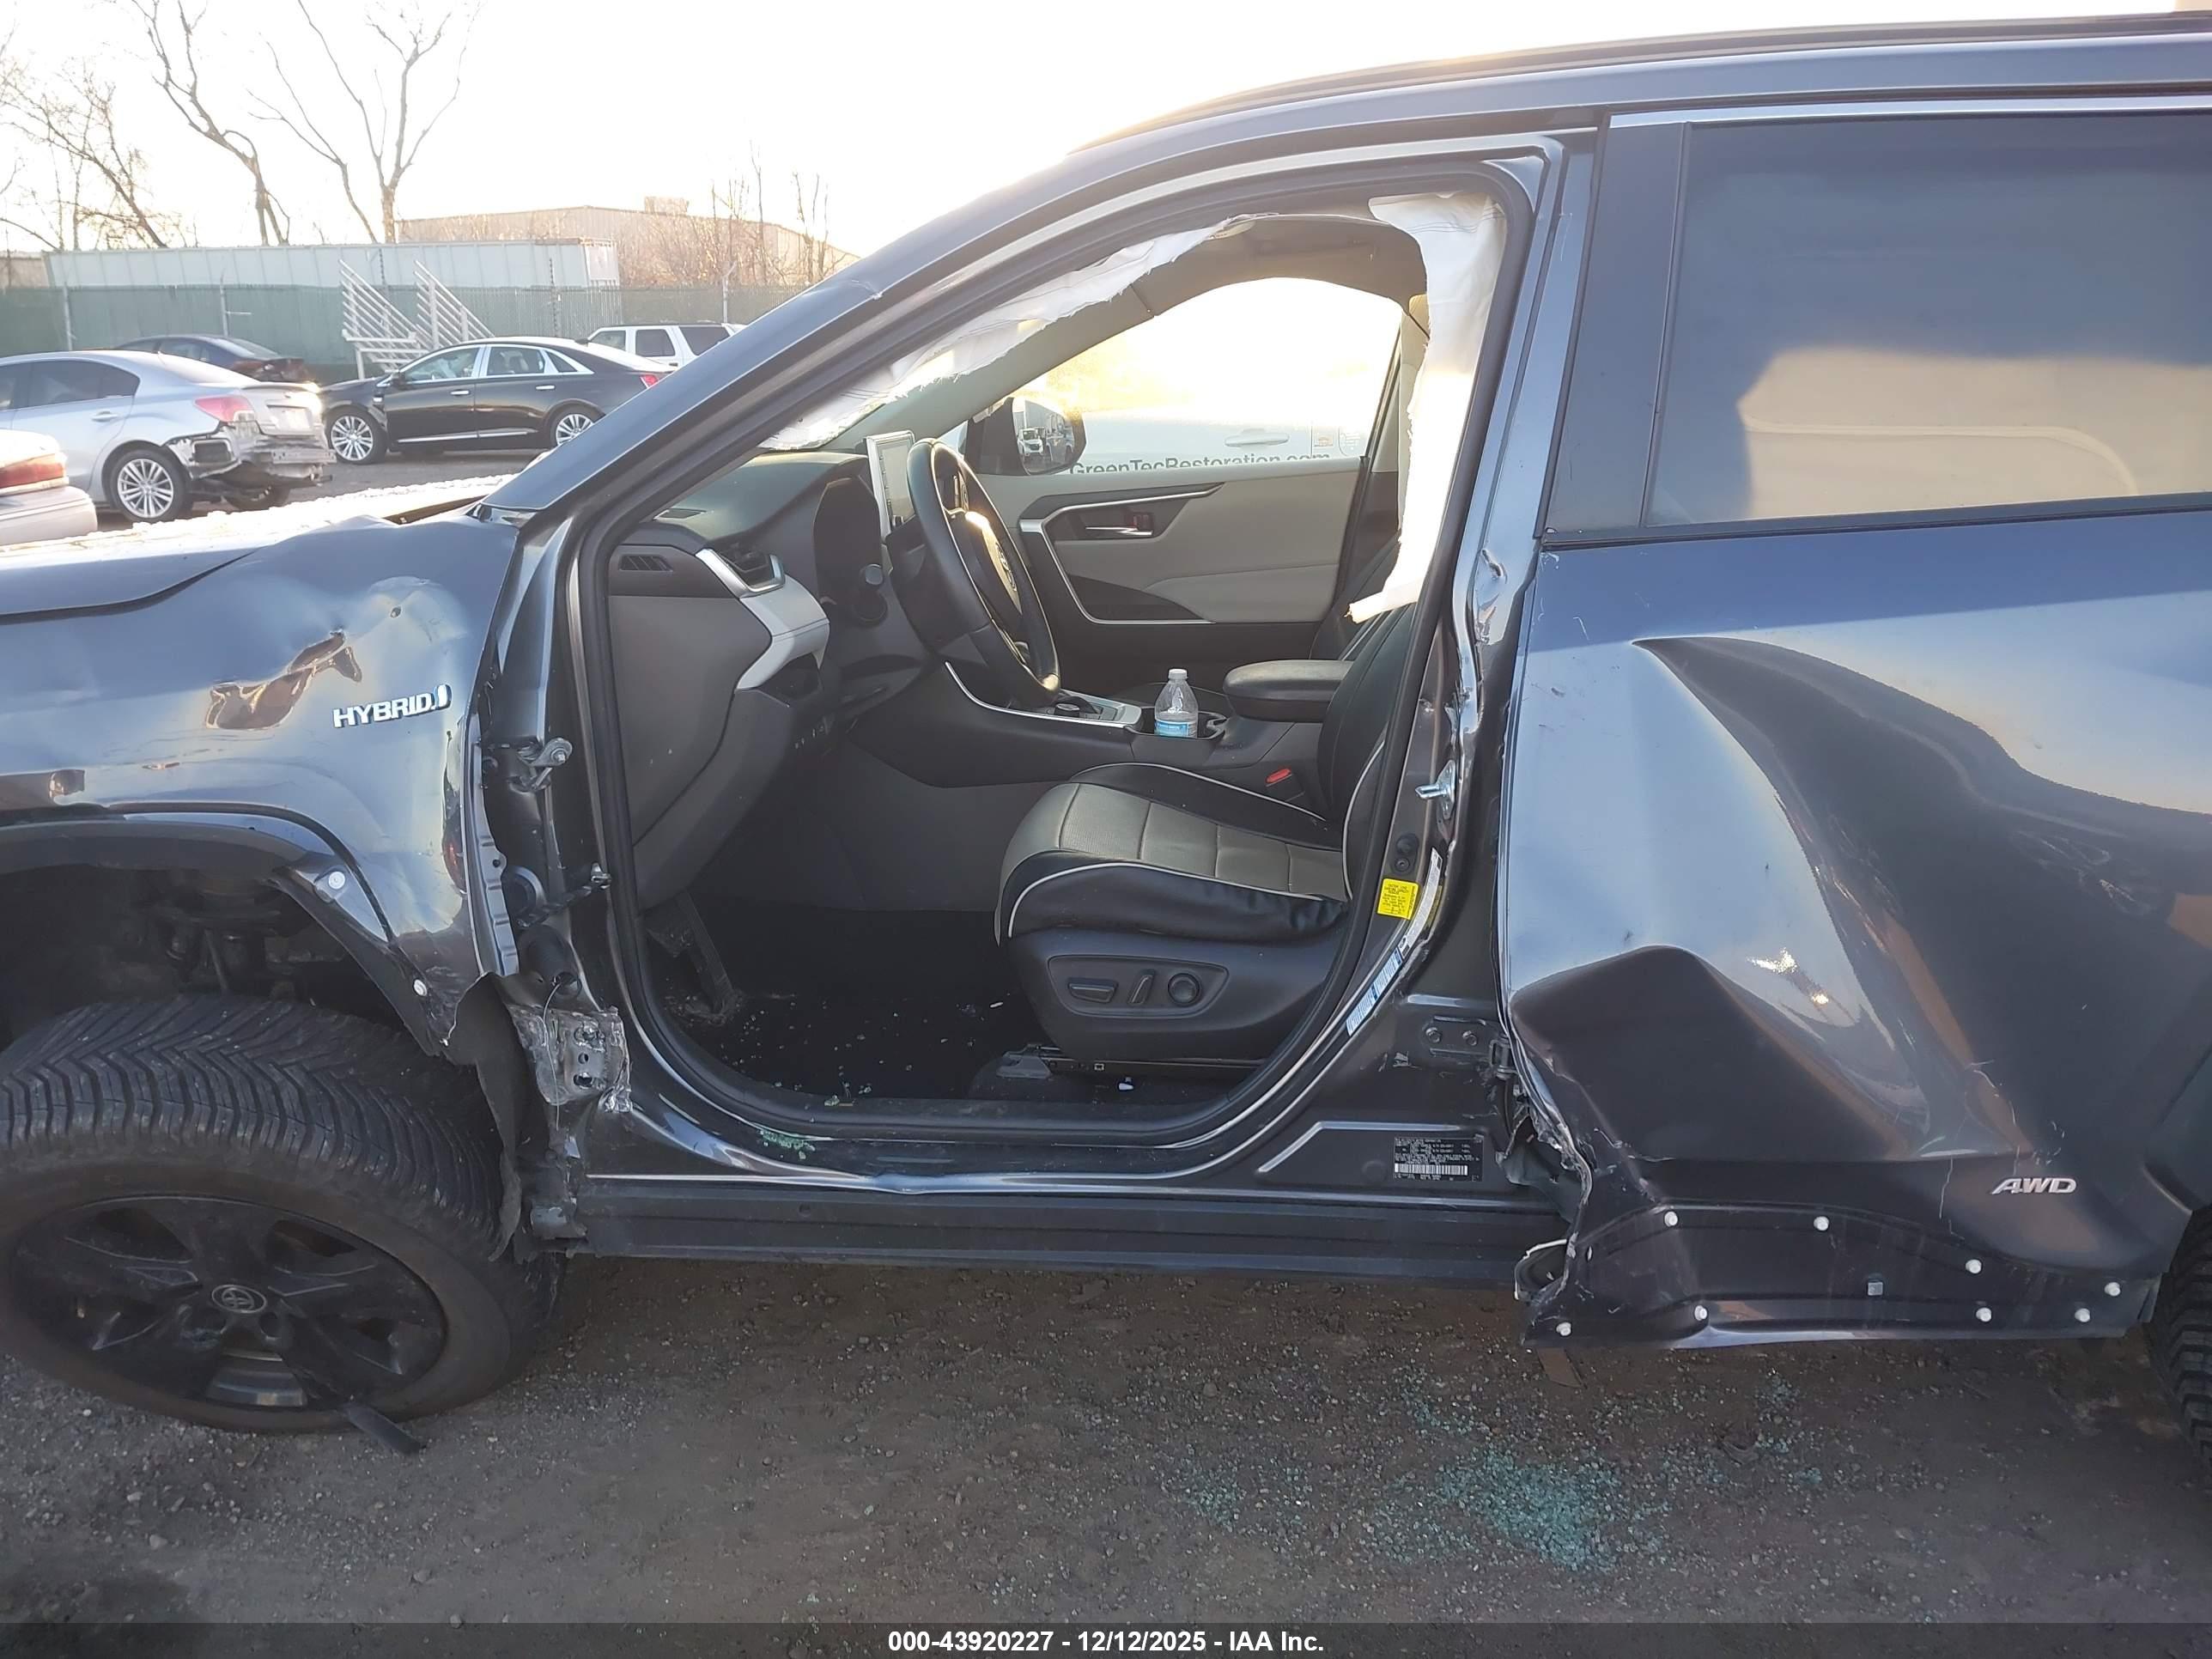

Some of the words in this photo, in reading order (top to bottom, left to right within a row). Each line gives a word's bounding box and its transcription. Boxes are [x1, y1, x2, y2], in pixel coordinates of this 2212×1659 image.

[1070, 453, 1330, 475] GreenTecRestorationcom
[333, 692, 433, 728] HYBRID
[1990, 1177, 2077, 1194] AWD
